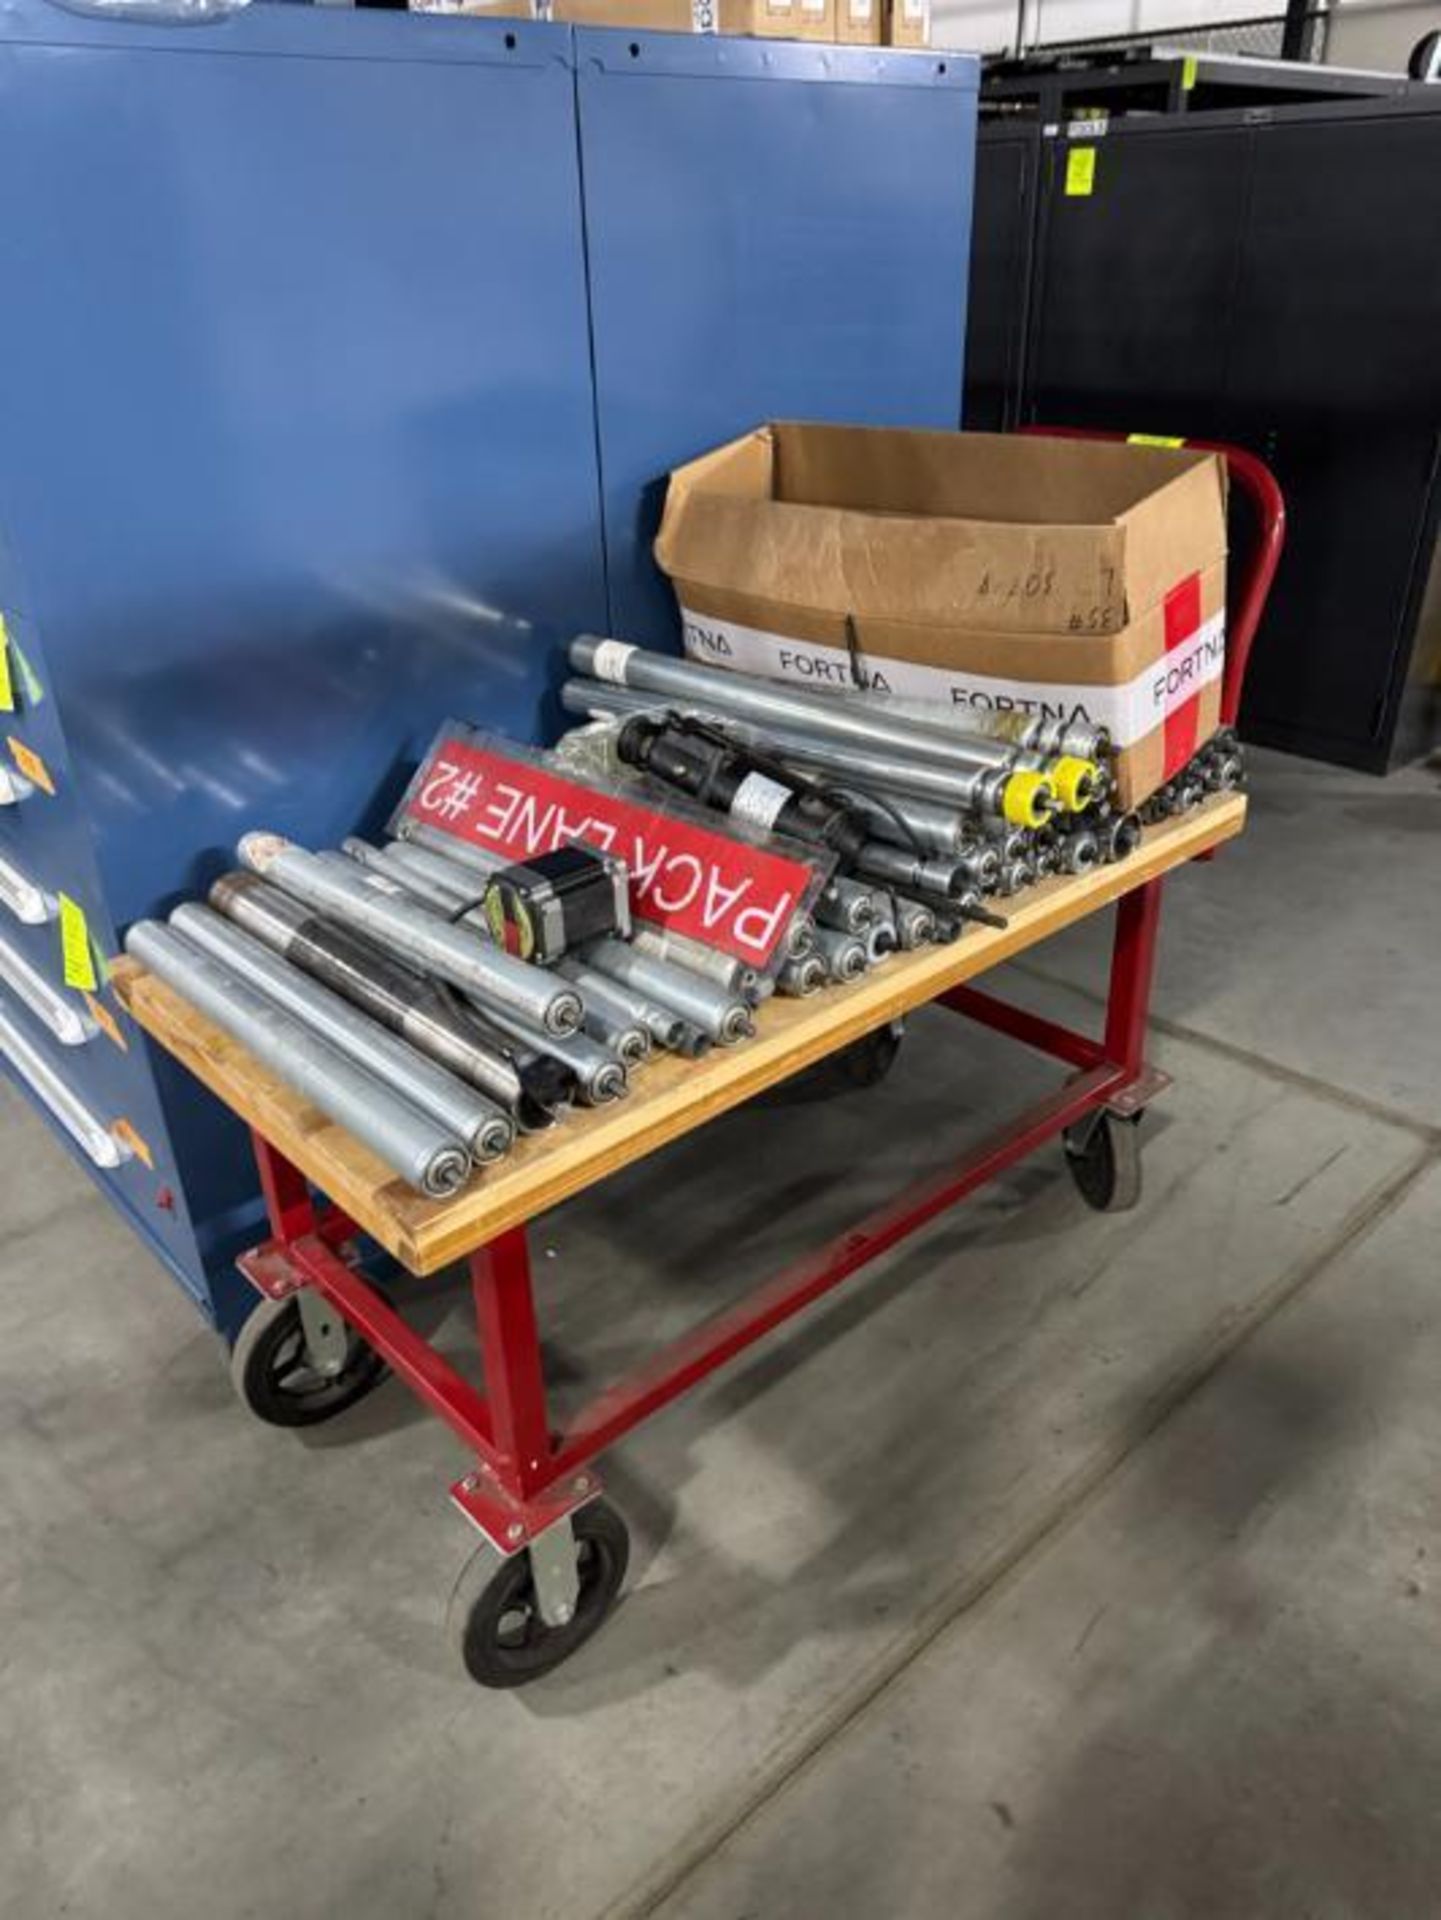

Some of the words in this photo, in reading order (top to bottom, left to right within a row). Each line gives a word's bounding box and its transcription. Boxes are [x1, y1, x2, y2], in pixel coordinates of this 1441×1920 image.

[686, 624, 733, 656] TNA
[420, 760, 484, 821] #2
[475, 781, 618, 854] LANE
[629, 835, 792, 950] PACK
